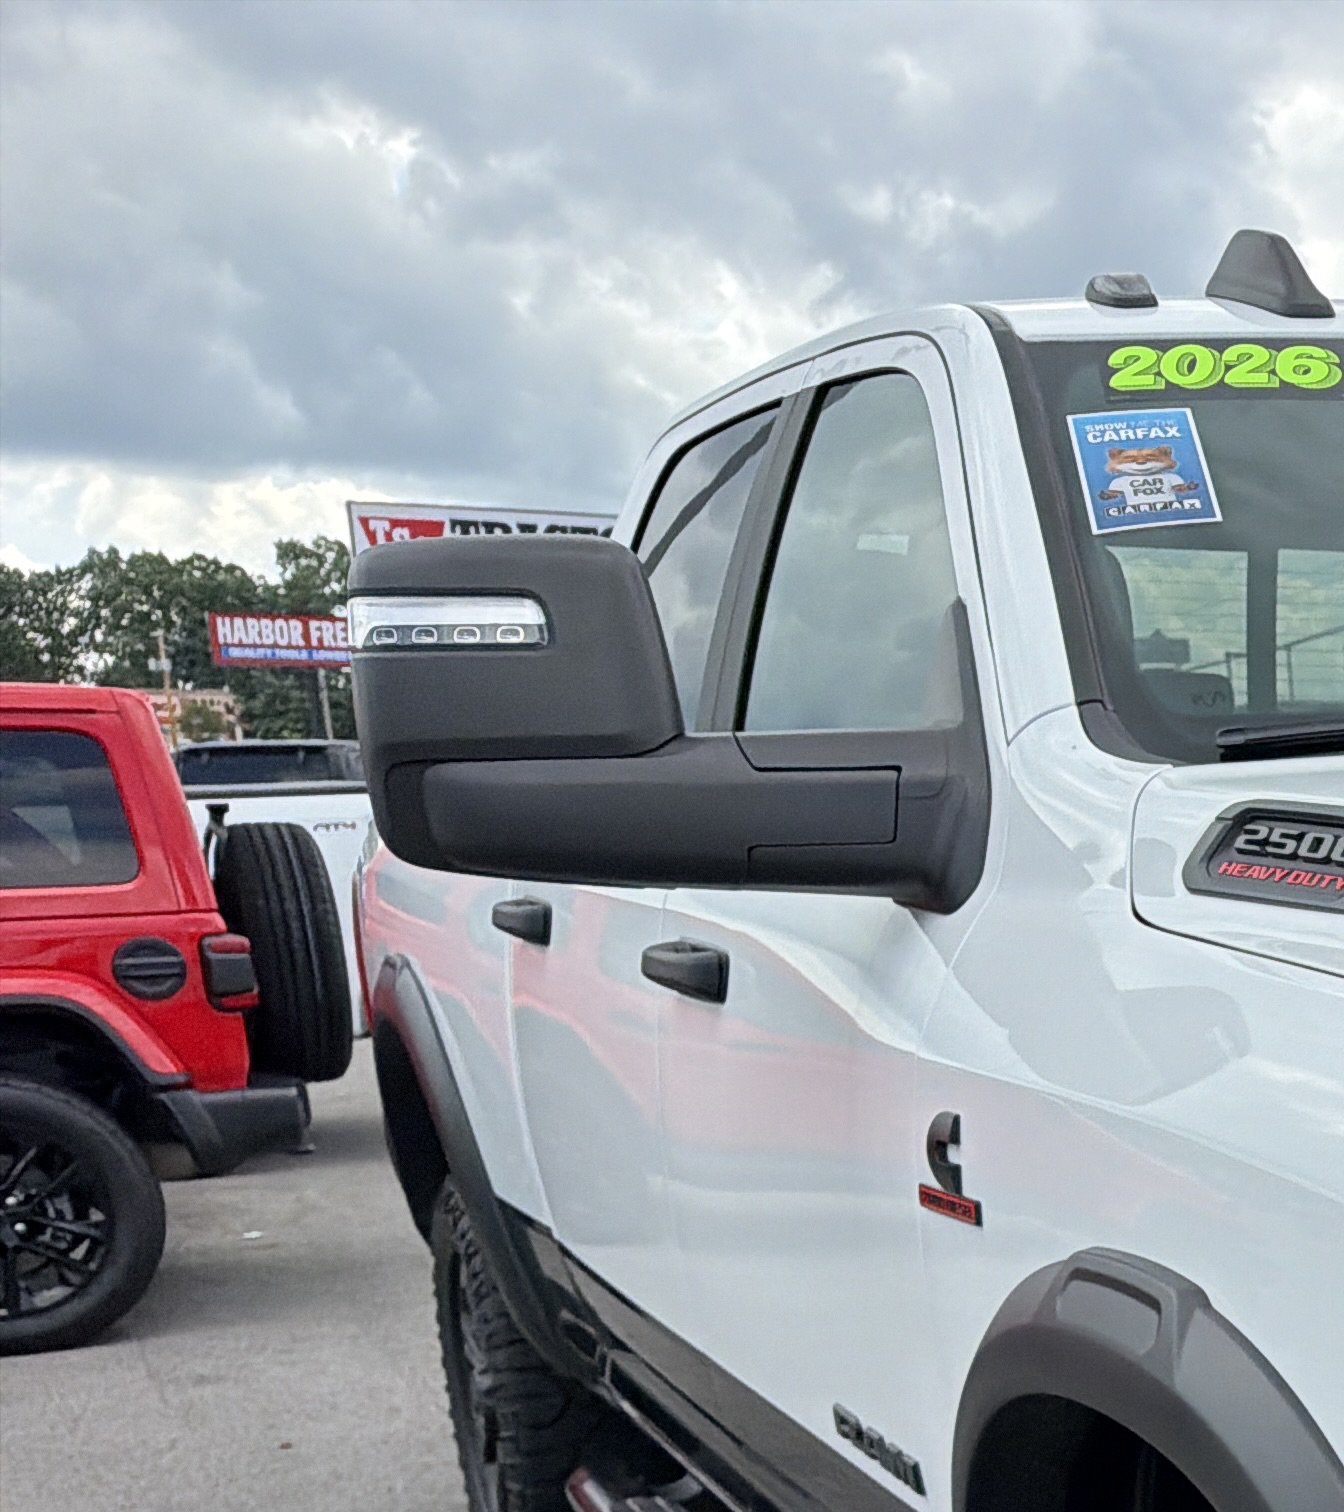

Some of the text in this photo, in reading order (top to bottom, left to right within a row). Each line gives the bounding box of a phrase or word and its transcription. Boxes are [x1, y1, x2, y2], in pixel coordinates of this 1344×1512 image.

[1107, 343, 1343, 391] 2026
[1085, 421, 1128, 433] SHOW
[1086, 425, 1182, 444] CARFAX
[1129, 477, 1165, 489] CAR
[1132, 487, 1167, 497] FOX
[1105, 499, 1201, 517] CARFAX
[215, 616, 306, 646] HARBOR
[1218, 861, 1291, 885] HEAVY
